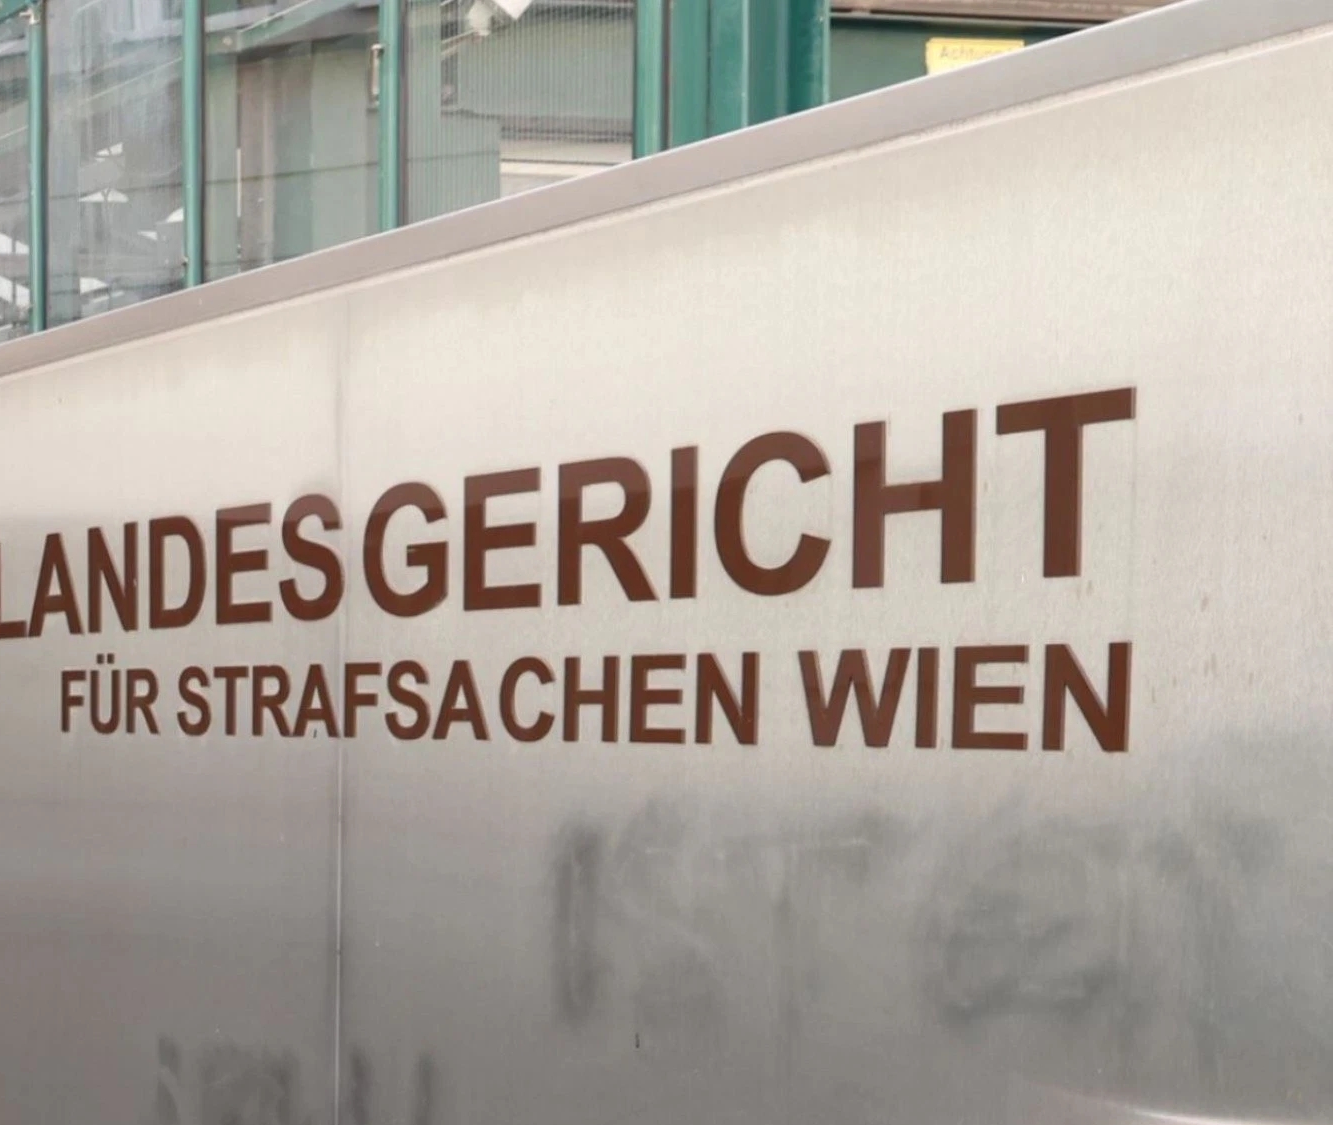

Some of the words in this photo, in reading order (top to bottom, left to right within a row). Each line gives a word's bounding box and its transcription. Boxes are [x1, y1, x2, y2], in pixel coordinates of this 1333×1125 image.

[59, 655, 159, 736] FÜR
[176, 652, 760, 746] STRAFSACHEN
[798, 641, 1132, 754] WIEN
